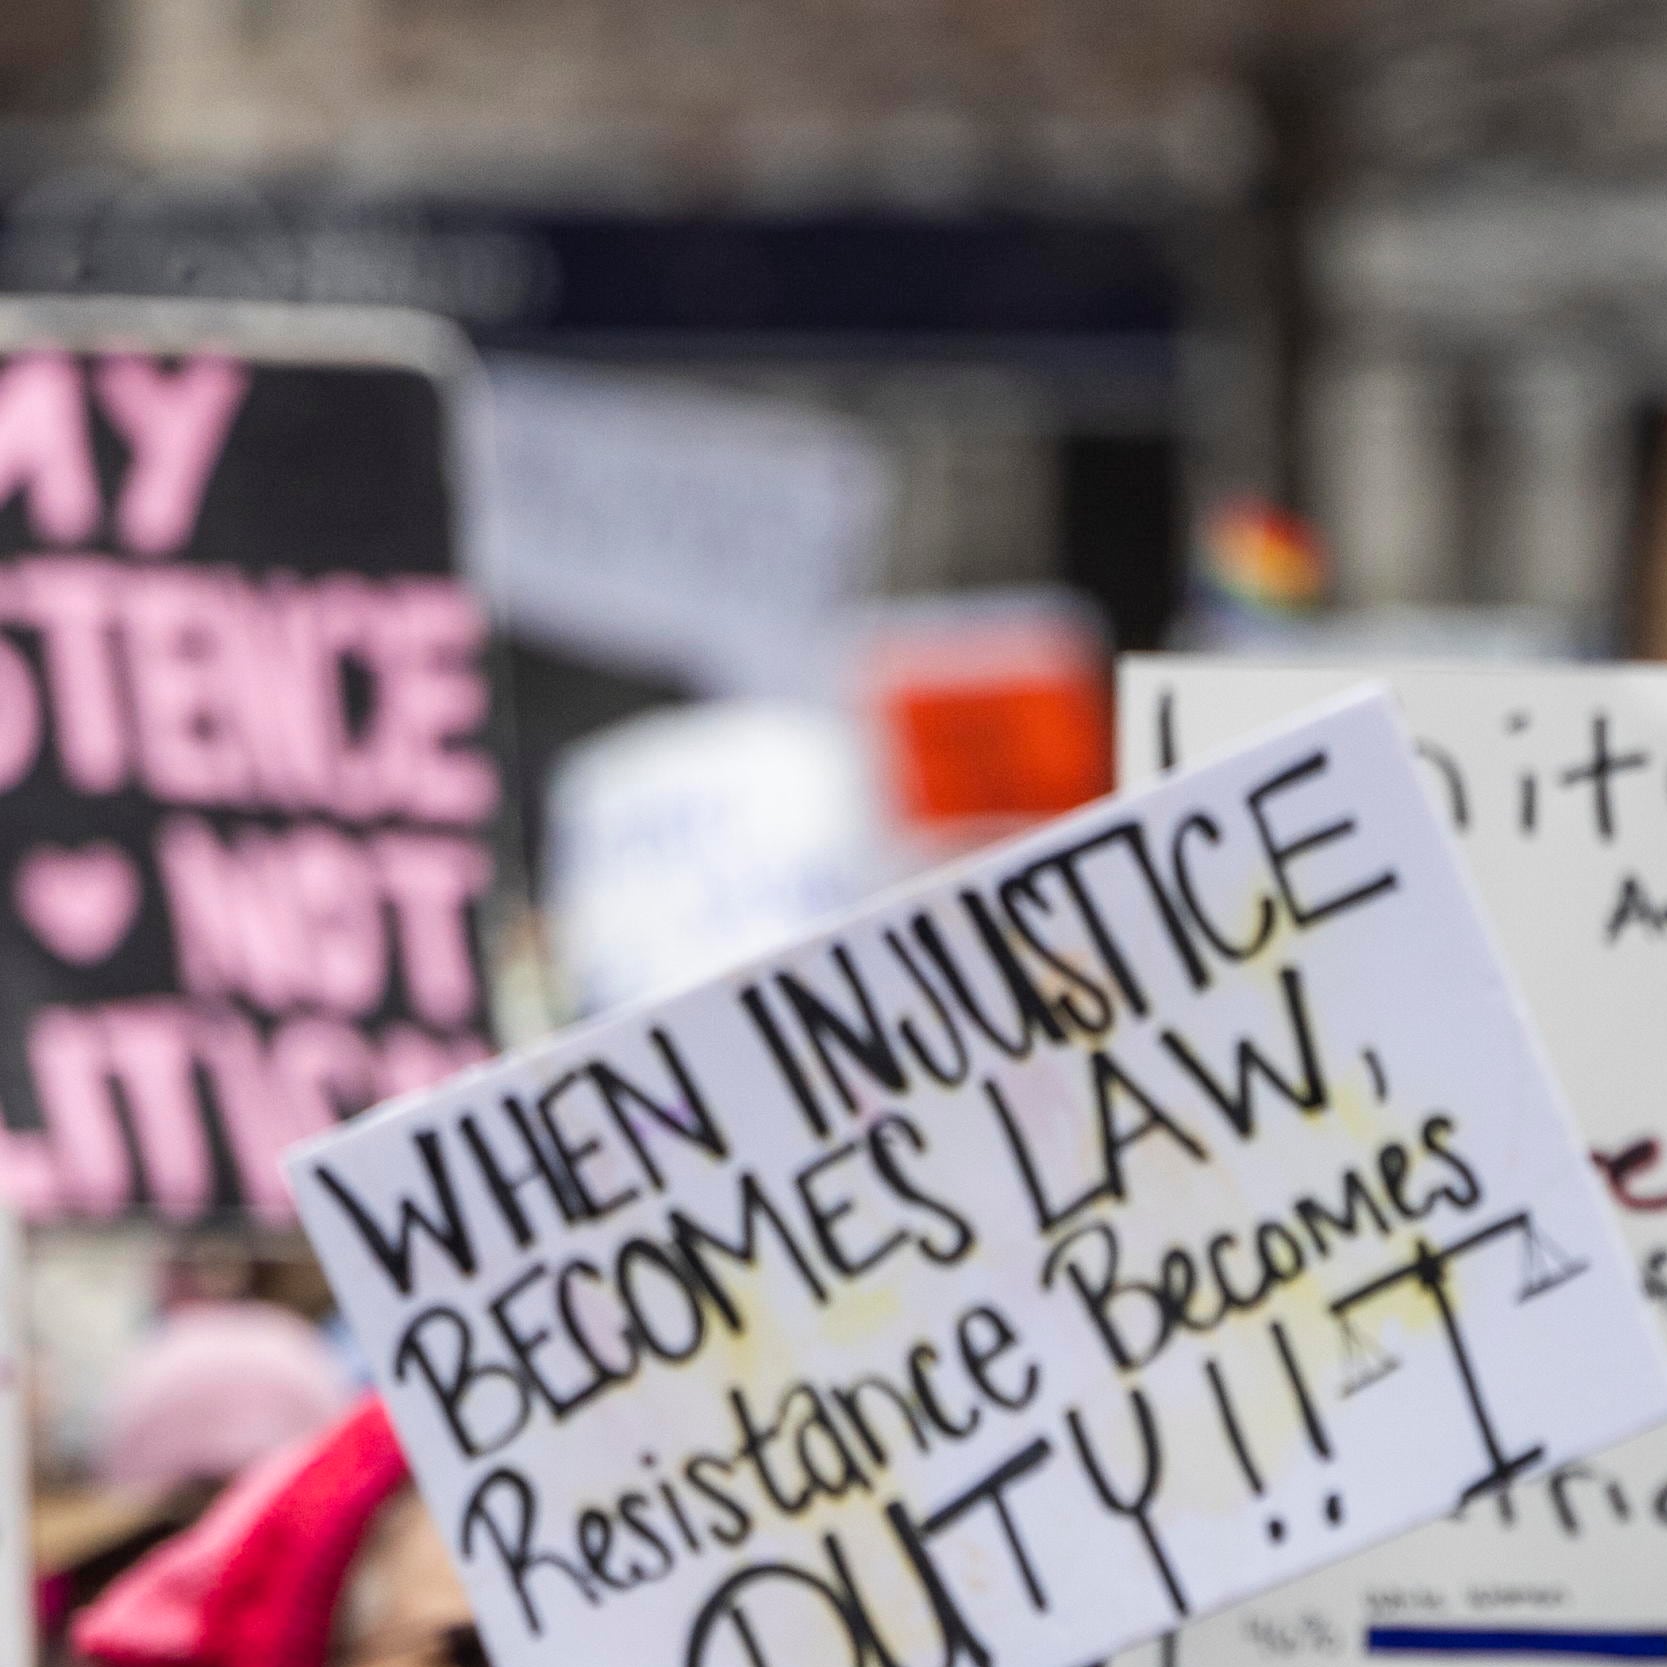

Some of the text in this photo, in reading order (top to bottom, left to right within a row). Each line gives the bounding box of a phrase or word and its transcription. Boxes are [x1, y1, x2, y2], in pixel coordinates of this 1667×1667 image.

[314, 1022, 730, 1297] WHEN
[738, 748, 1400, 1142] INJUSTICE
[396, 965, 1391, 1461] BECOMES LAW,
[460, 1113, 1486, 1638] Resistance Becomes
